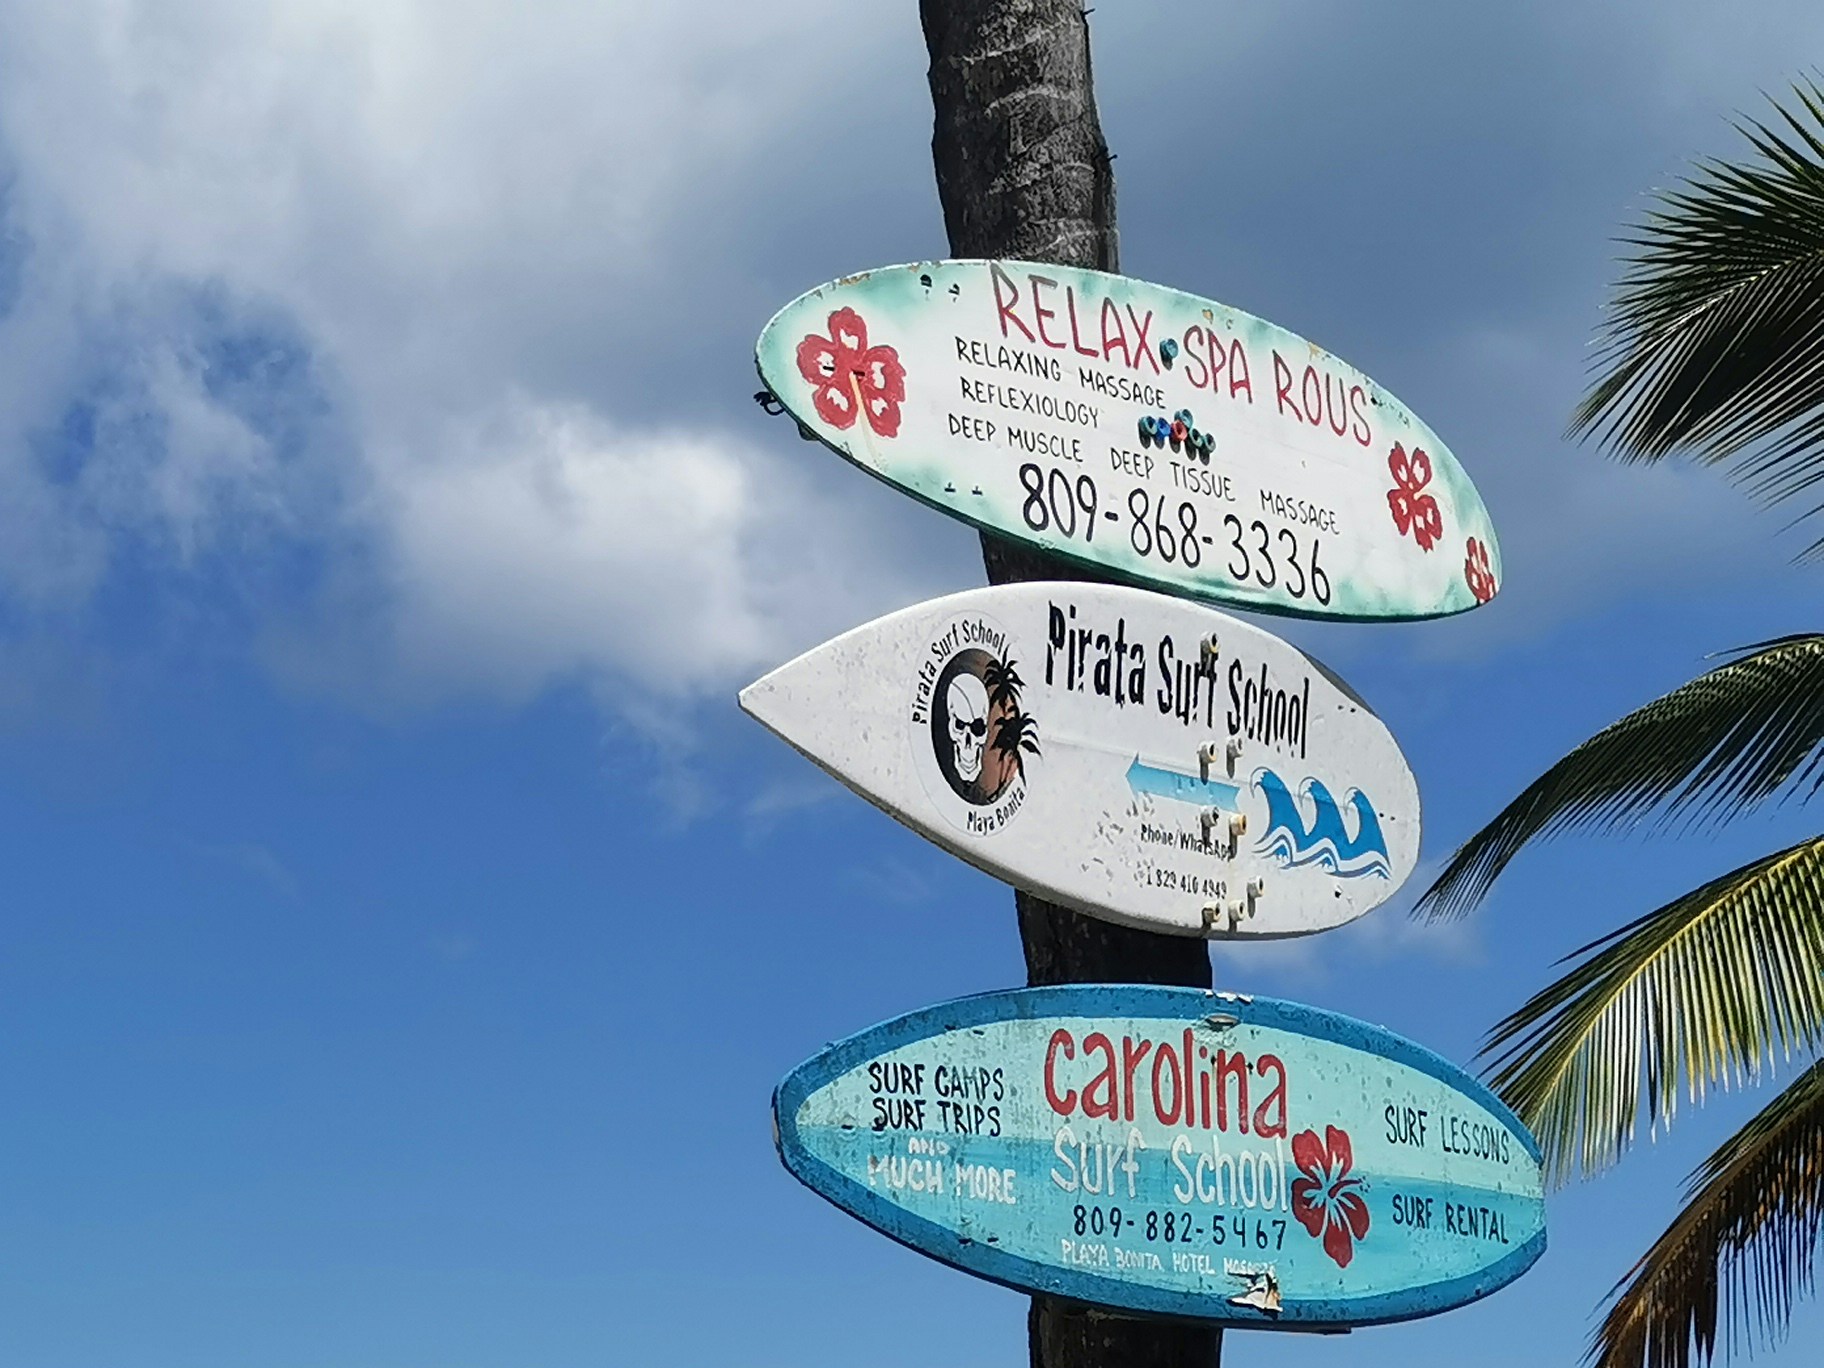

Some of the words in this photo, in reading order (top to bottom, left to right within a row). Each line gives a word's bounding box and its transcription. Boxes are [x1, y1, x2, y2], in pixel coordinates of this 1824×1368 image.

[955, 336, 1061, 381] RELAXING
[1078, 367, 1166, 409] MASSAGE
[990, 262, 1160, 375] RELAX
[1184, 325, 1253, 404] SPA
[1272, 349, 1371, 446] ROUS
[960, 376, 1099, 428] REFLEXIOLOGY
[948, 413, 996, 442] DEEP
[1007, 426, 1083, 462] MUSCLE
[1110, 447, 1154, 479] DEEP
[1170, 461, 1236, 501] TISSUE
[1260, 489, 1340, 535] MASSAGE
[1018, 462, 1331, 606] 809-868-3336
[911, 660, 937, 724] Pirata
[931, 623, 958, 662] Surf
[961, 618, 1006, 656] School
[1046, 600, 1146, 709] Pirata
[1157, 634, 1218, 728] Surf
[1227, 658, 1310, 759] School
[966, 810, 995, 836] Playa
[996, 786, 1026, 827] Bonita
[1156, 868, 1177, 889] 829
[867, 1061, 925, 1095] SURF
[934, 1065, 1004, 1101] CAMPS
[872, 1097, 926, 1132] SURF
[937, 1100, 1001, 1137] TRIPS
[1385, 1104, 1427, 1148] SURF
[1440, 1115, 1509, 1164] LESSONS
[867, 1154, 943, 1194] MUCH
[955, 1163, 1016, 1205] MORE
[1051, 1126, 1147, 1199] Surf
[1172, 1133, 1288, 1212] School
[1073, 1204, 1287, 1250] 809-882-5467
[1392, 1194, 1433, 1229] SURF
[1445, 1201, 1509, 1244] RENTAL
[1061, 1239, 1110, 1267] PLAYA
[1173, 1252, 1216, 1275] HOTEL
